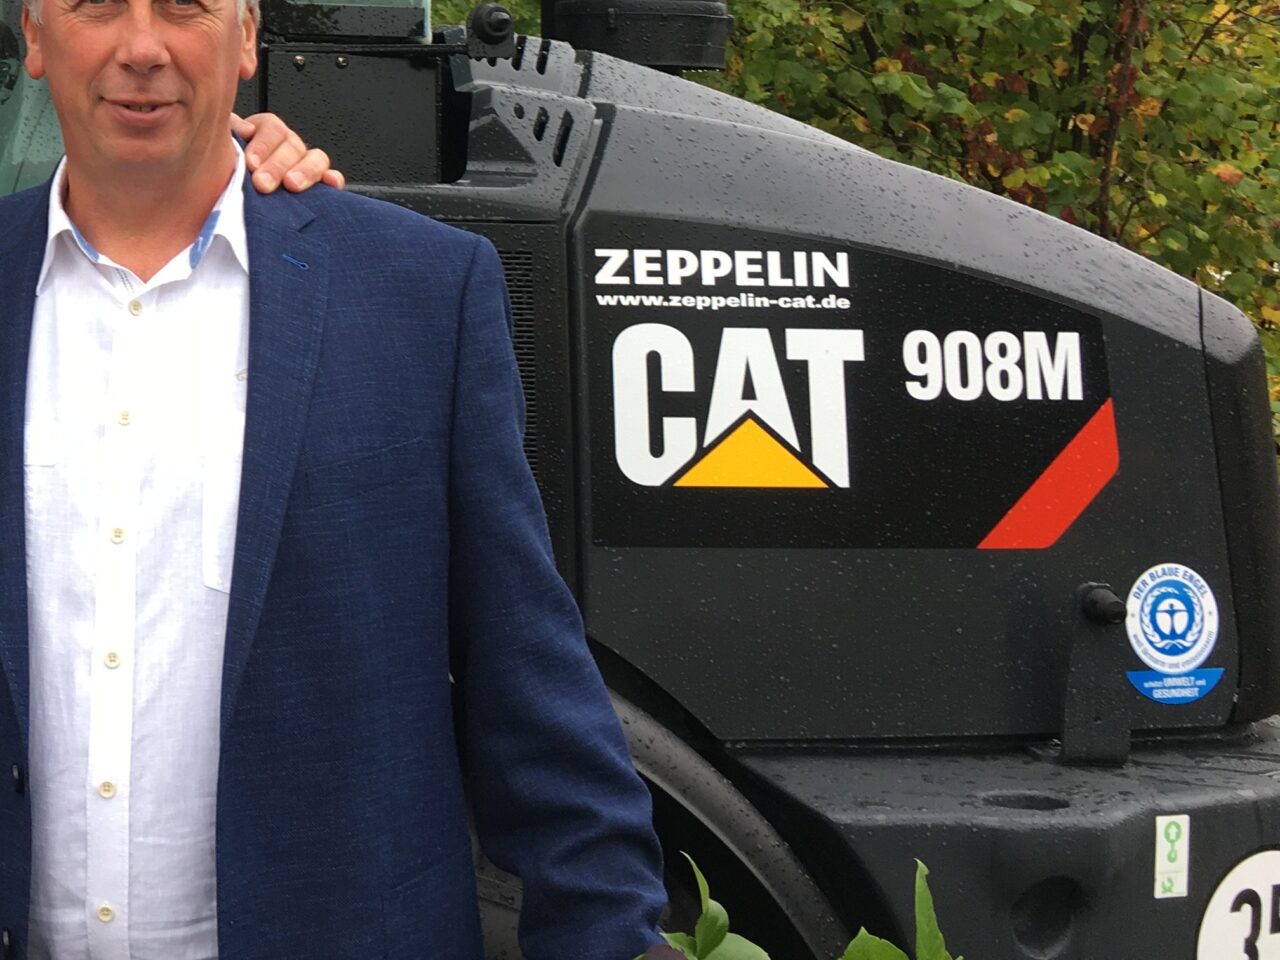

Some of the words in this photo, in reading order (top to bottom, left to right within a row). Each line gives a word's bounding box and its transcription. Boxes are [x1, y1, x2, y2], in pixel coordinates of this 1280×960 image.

[594, 248, 850, 288] ZEPPELIN
[595, 293, 851, 311] www.zeppelin-cat.de
[902, 330, 1084, 401] 908M
[612, 323, 865, 489] CAT
[1133, 579, 1149, 600] DER
[1148, 567, 1180, 582] BLAUE
[1182, 570, 1209, 599] ENGEL
[1152, 687, 1199, 698] GESUNDHEIT
[1163, 676, 1195, 687] UMWELT
[1230, 888, 1280, 960] 3
